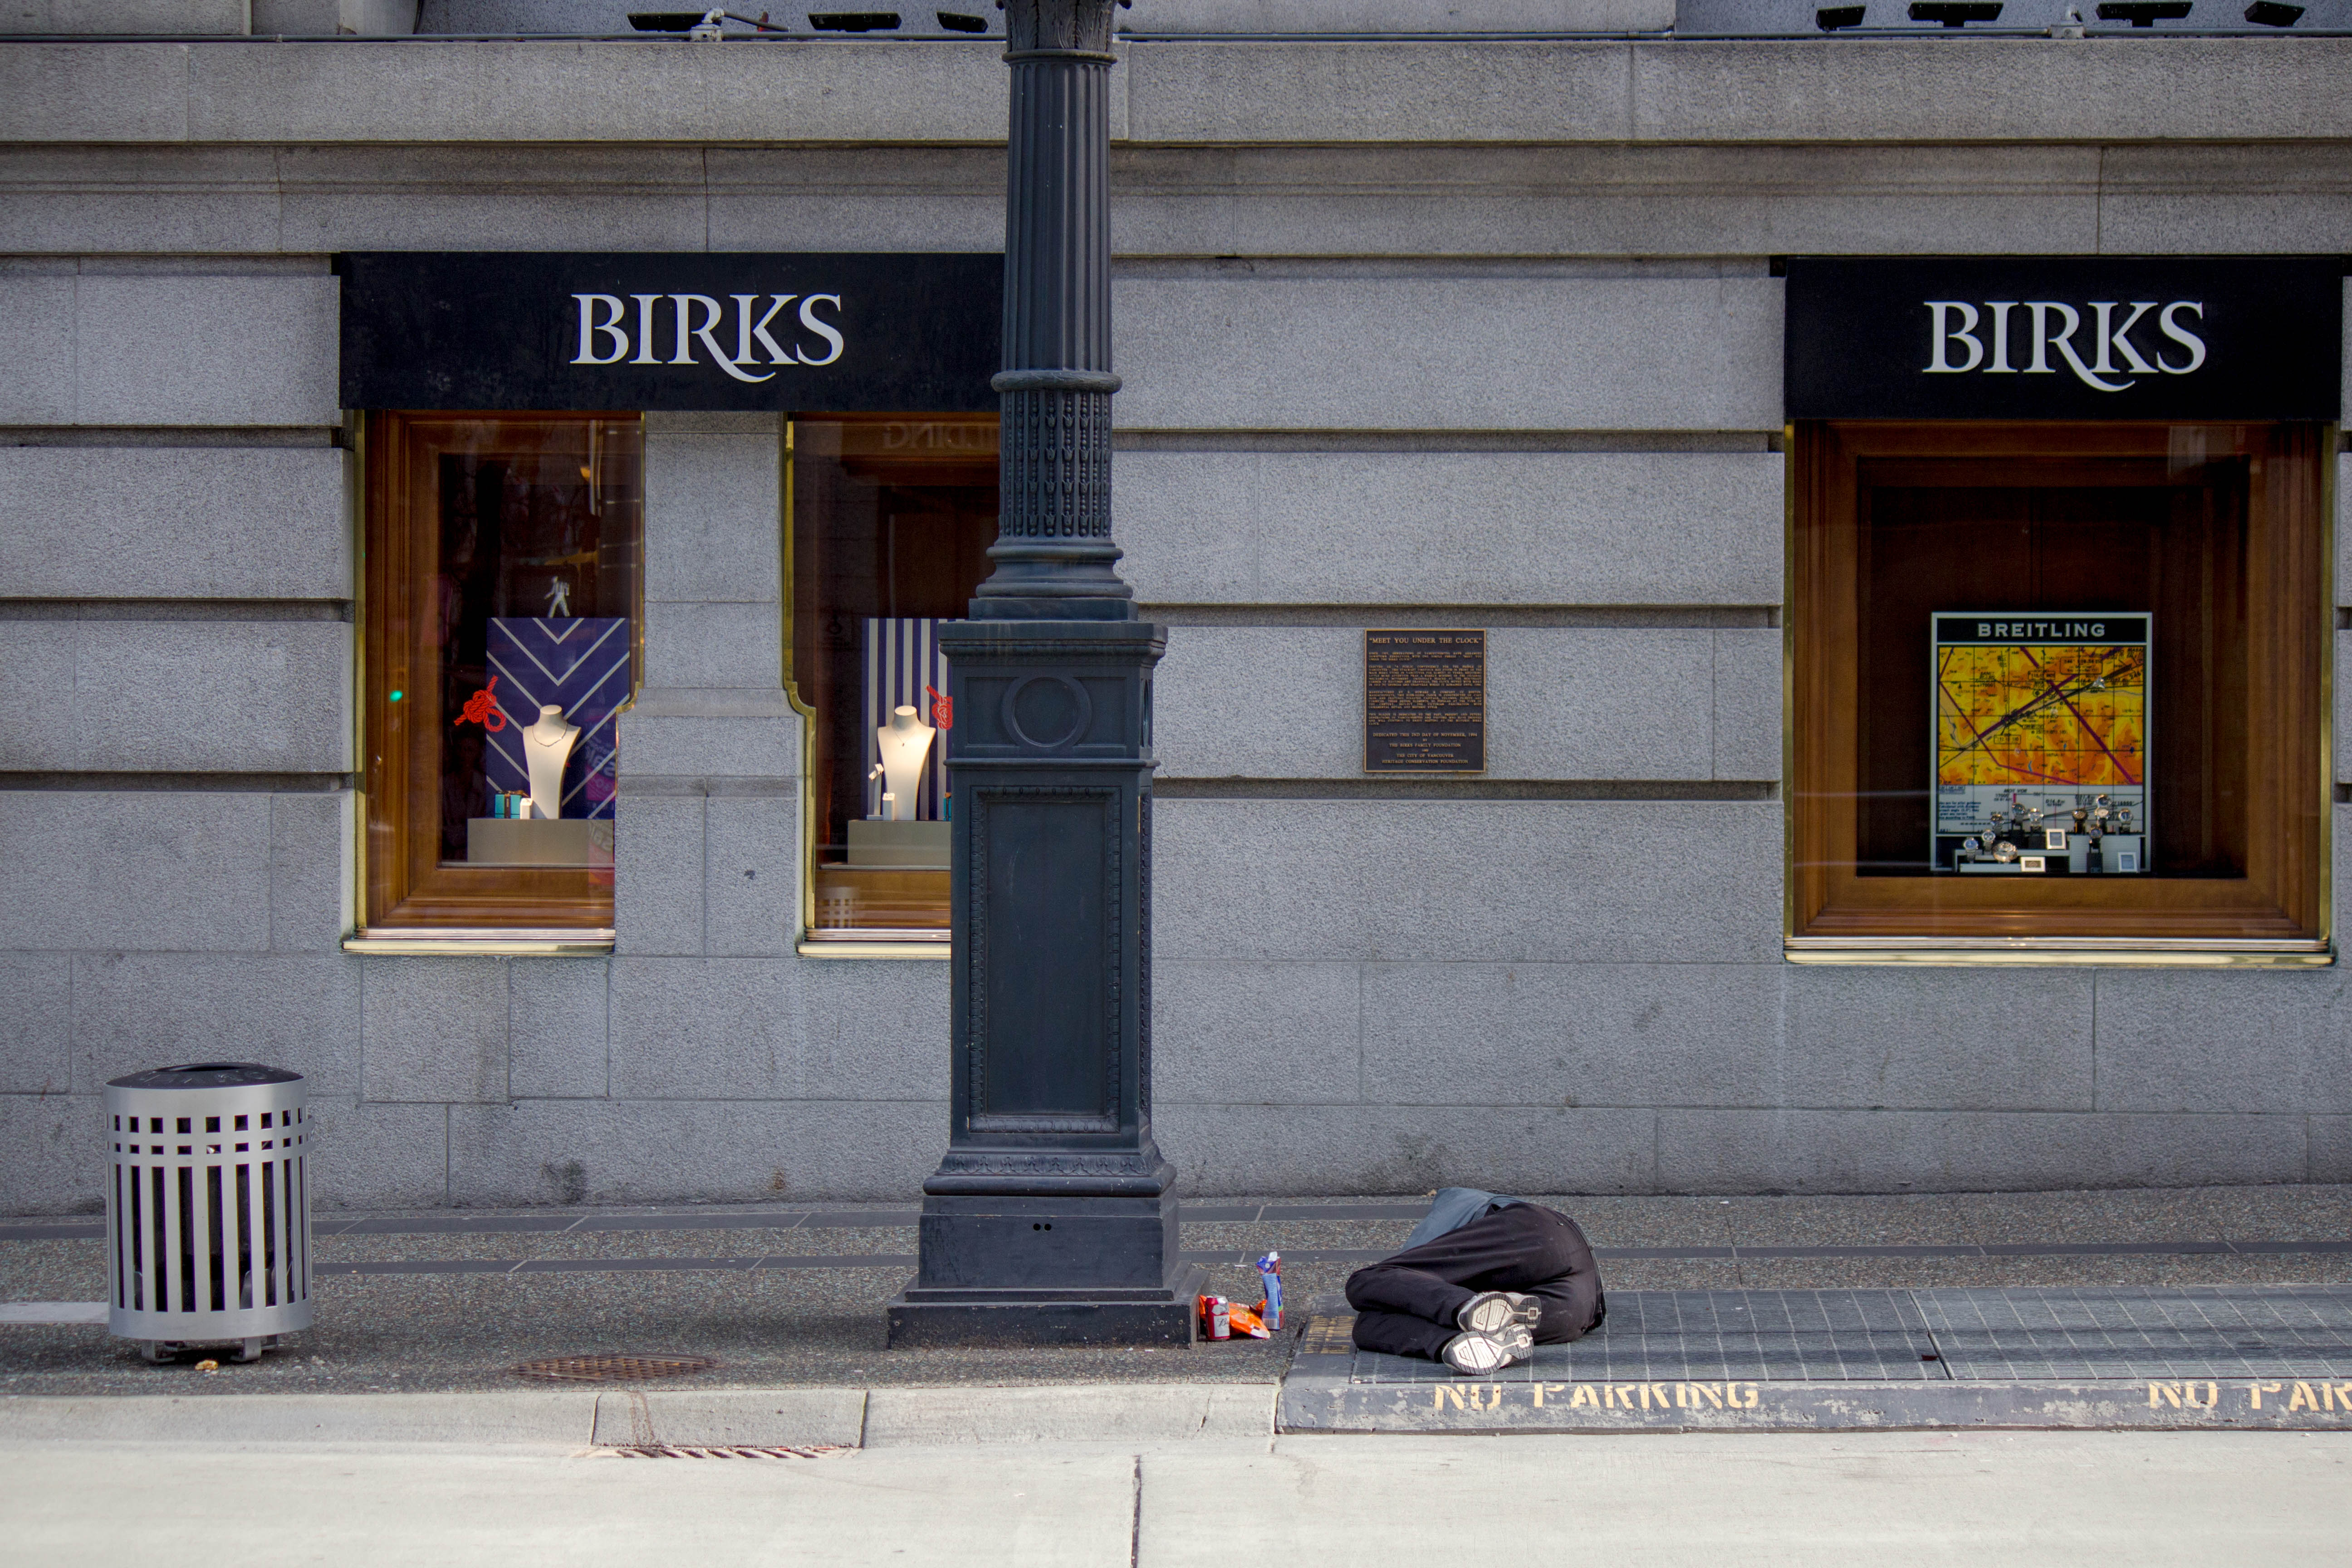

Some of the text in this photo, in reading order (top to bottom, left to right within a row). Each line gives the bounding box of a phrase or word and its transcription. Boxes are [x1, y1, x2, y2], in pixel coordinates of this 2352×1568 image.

[570, 294, 844, 382] BIRKS
[1922, 302, 2206, 392] BIRKS
[1977, 623, 2106, 637] BREITLING
[1435, 1382, 1759, 1410] NO PARKING
[2149, 1381, 2218, 1409] NO
